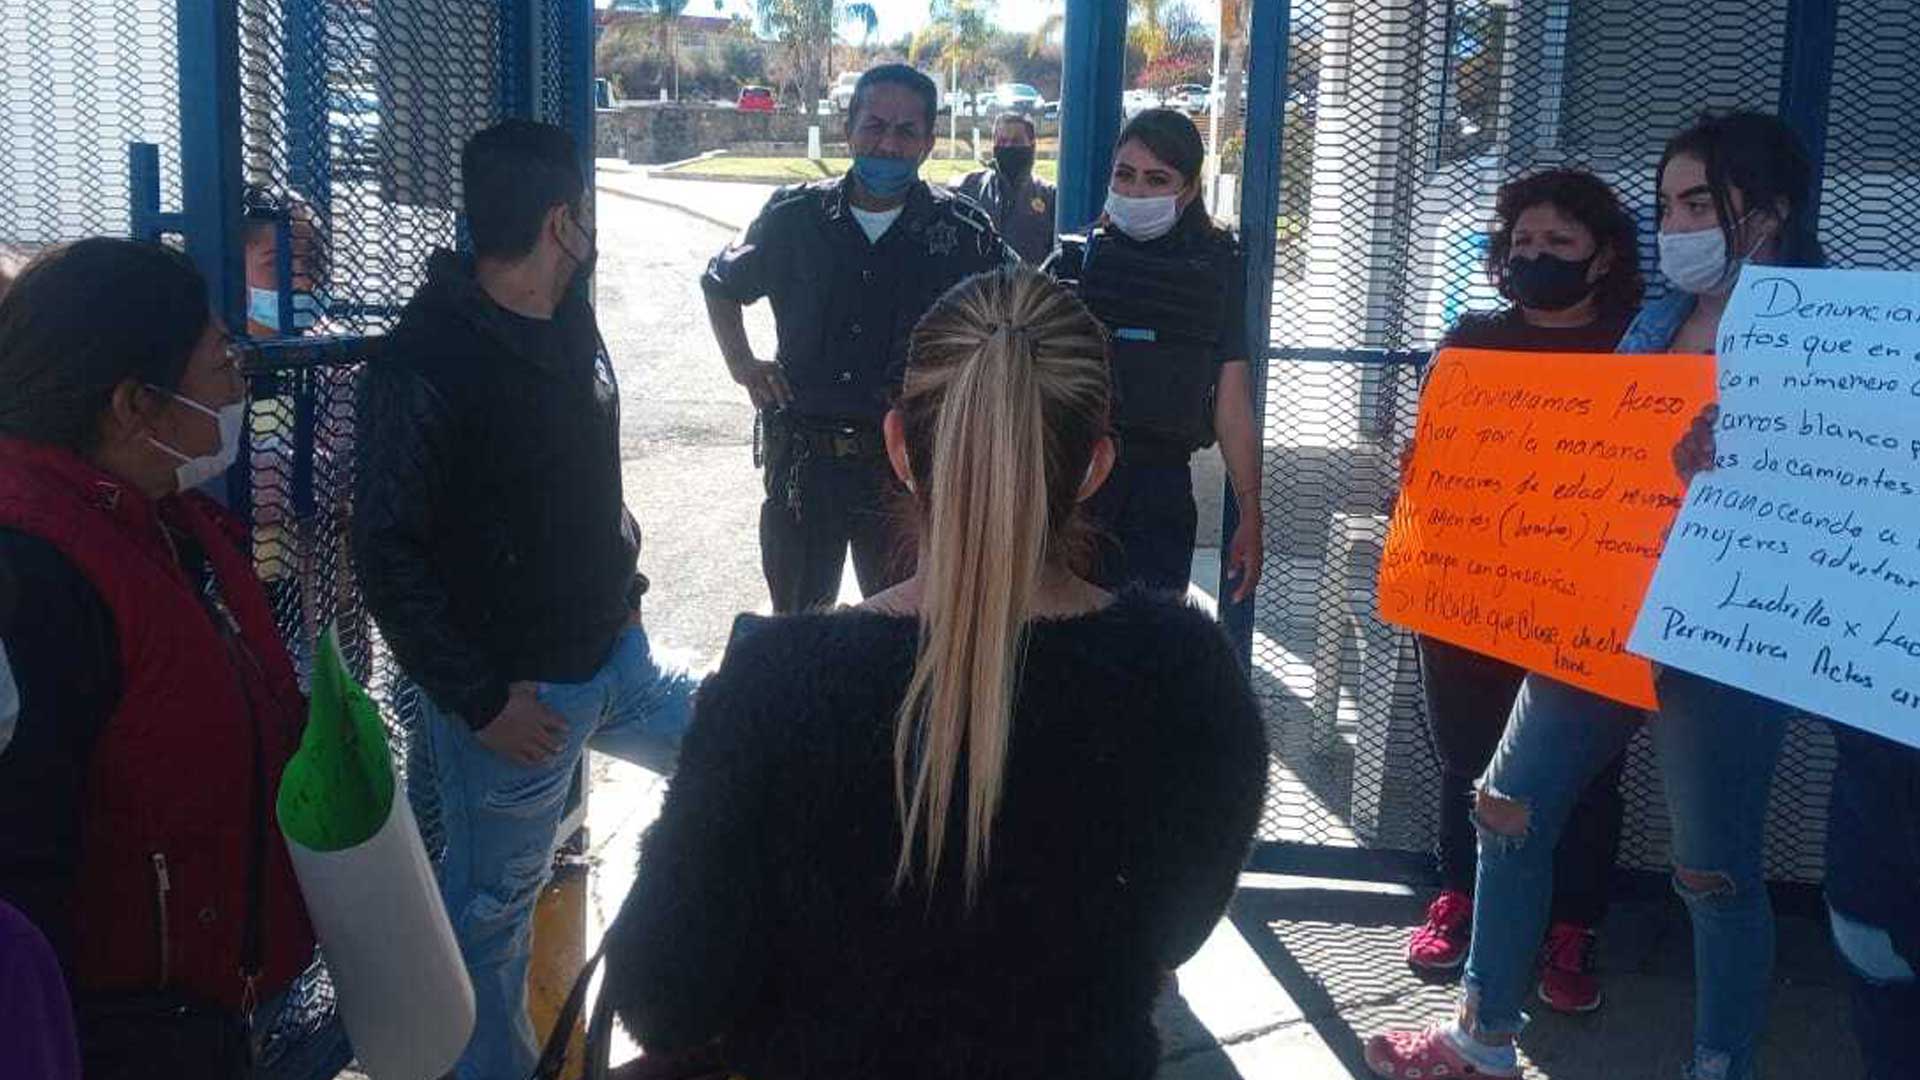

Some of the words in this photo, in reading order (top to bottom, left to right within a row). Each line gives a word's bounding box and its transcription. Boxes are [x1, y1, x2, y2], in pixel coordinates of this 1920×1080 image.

[1751, 277, 1920, 323] Denuncia
[1803, 334, 1853, 368] que
[1868, 342, 1901, 358] en
[1799, 408, 1899, 449] blanco
[1553, 471, 1615, 501] edad
[1681, 520, 1789, 562] mujeres
[1879, 528, 1899, 543] a
[1717, 571, 1831, 627] Ladrillo
[1812, 645, 1874, 689] Actos
